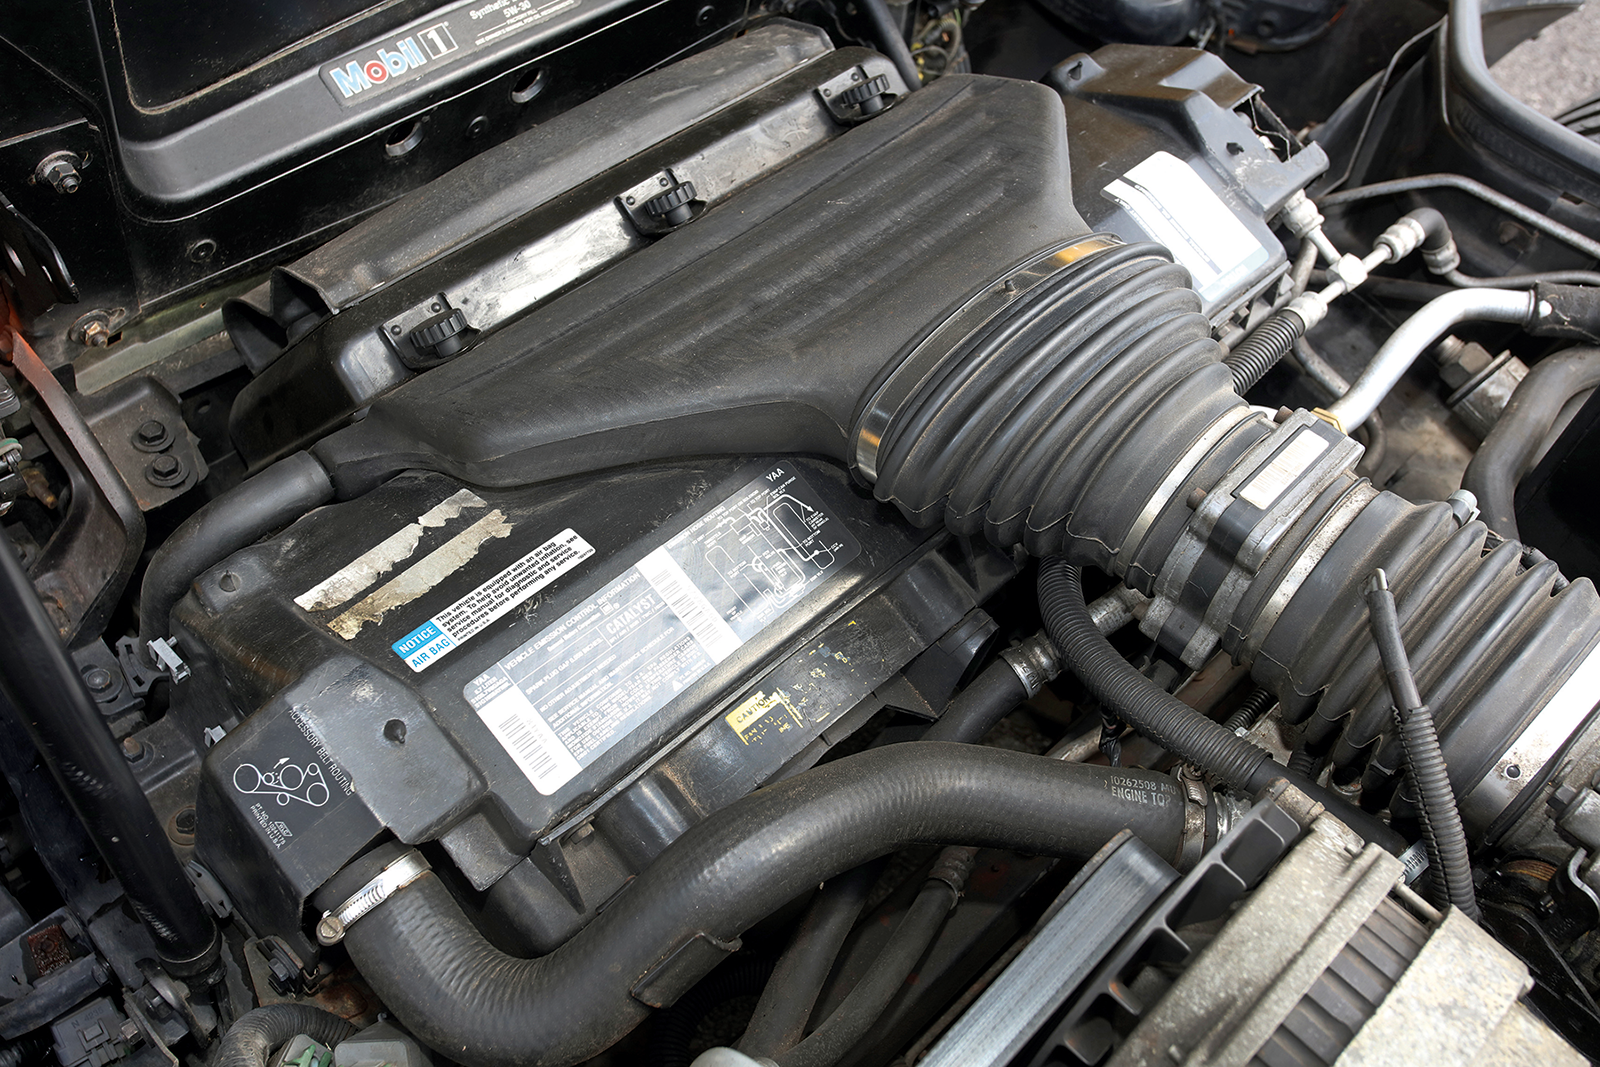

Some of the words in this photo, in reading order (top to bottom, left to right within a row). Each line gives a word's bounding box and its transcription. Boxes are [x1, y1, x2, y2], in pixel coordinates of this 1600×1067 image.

[503, 0, 531, 18] 5W-30
[329, 36, 427, 98] Mobil
[765, 466, 785, 483] YAA
[688, 519, 705, 533] HOSE
[702, 505, 726, 523] ROUTING
[435, 610, 452, 622] This
[450, 594, 476, 613] vehicle
[473, 589, 482, 597] is
[480, 570, 513, 593] equipped
[509, 560, 526, 572] with
[523, 554, 535, 563] an
[532, 549, 544, 557] air
[541, 540, 556, 552] bag
[440, 607, 469, 628] system.
[466, 601, 478, 611] To
[475, 591, 492, 604] help
[489, 579, 510, 594] avoid
[508, 559, 540, 582] unwanted
[564, 534, 578, 544] see
[445, 614, 471, 632] service
[469, 597, 495, 616] manual
[493, 591, 505, 600] for
[503, 568, 539, 594] diagnostic
[535, 560, 551, 571] and
[548, 545, 572, 563] service
[450, 609, 489, 638] procedures
[487, 595, 510, 612] before
[508, 572, 545, 598] performing
[542, 564, 557, 575] any
[604, 592, 657, 635] CATALYST
[504, 646, 535, 671] VEHICLE
[533, 623, 567, 650] EMISSION
[564, 601, 598, 627] CONTROL
[595, 570, 641, 605] INFORMATION
[398, 625, 437, 654] NOTICE
[409, 651, 431, 668] AIR
[427, 637, 451, 655] BAG
[472, 672, 490, 687] YAA
[542, 668, 559, 682] PLUG
[557, 659, 571, 671] GAP
[546, 691, 565, 707] OTHER
[734, 694, 771, 724] CAUTION
[288, 707, 320, 748] ACCESSORY
[317, 747, 332, 766] BELT
[328, 763, 354, 796] ROUTING
[1110, 776, 1156, 790] 10262508
[1111, 786, 1148, 804] ENGINE
[248, 805, 268, 828] PRINTED
